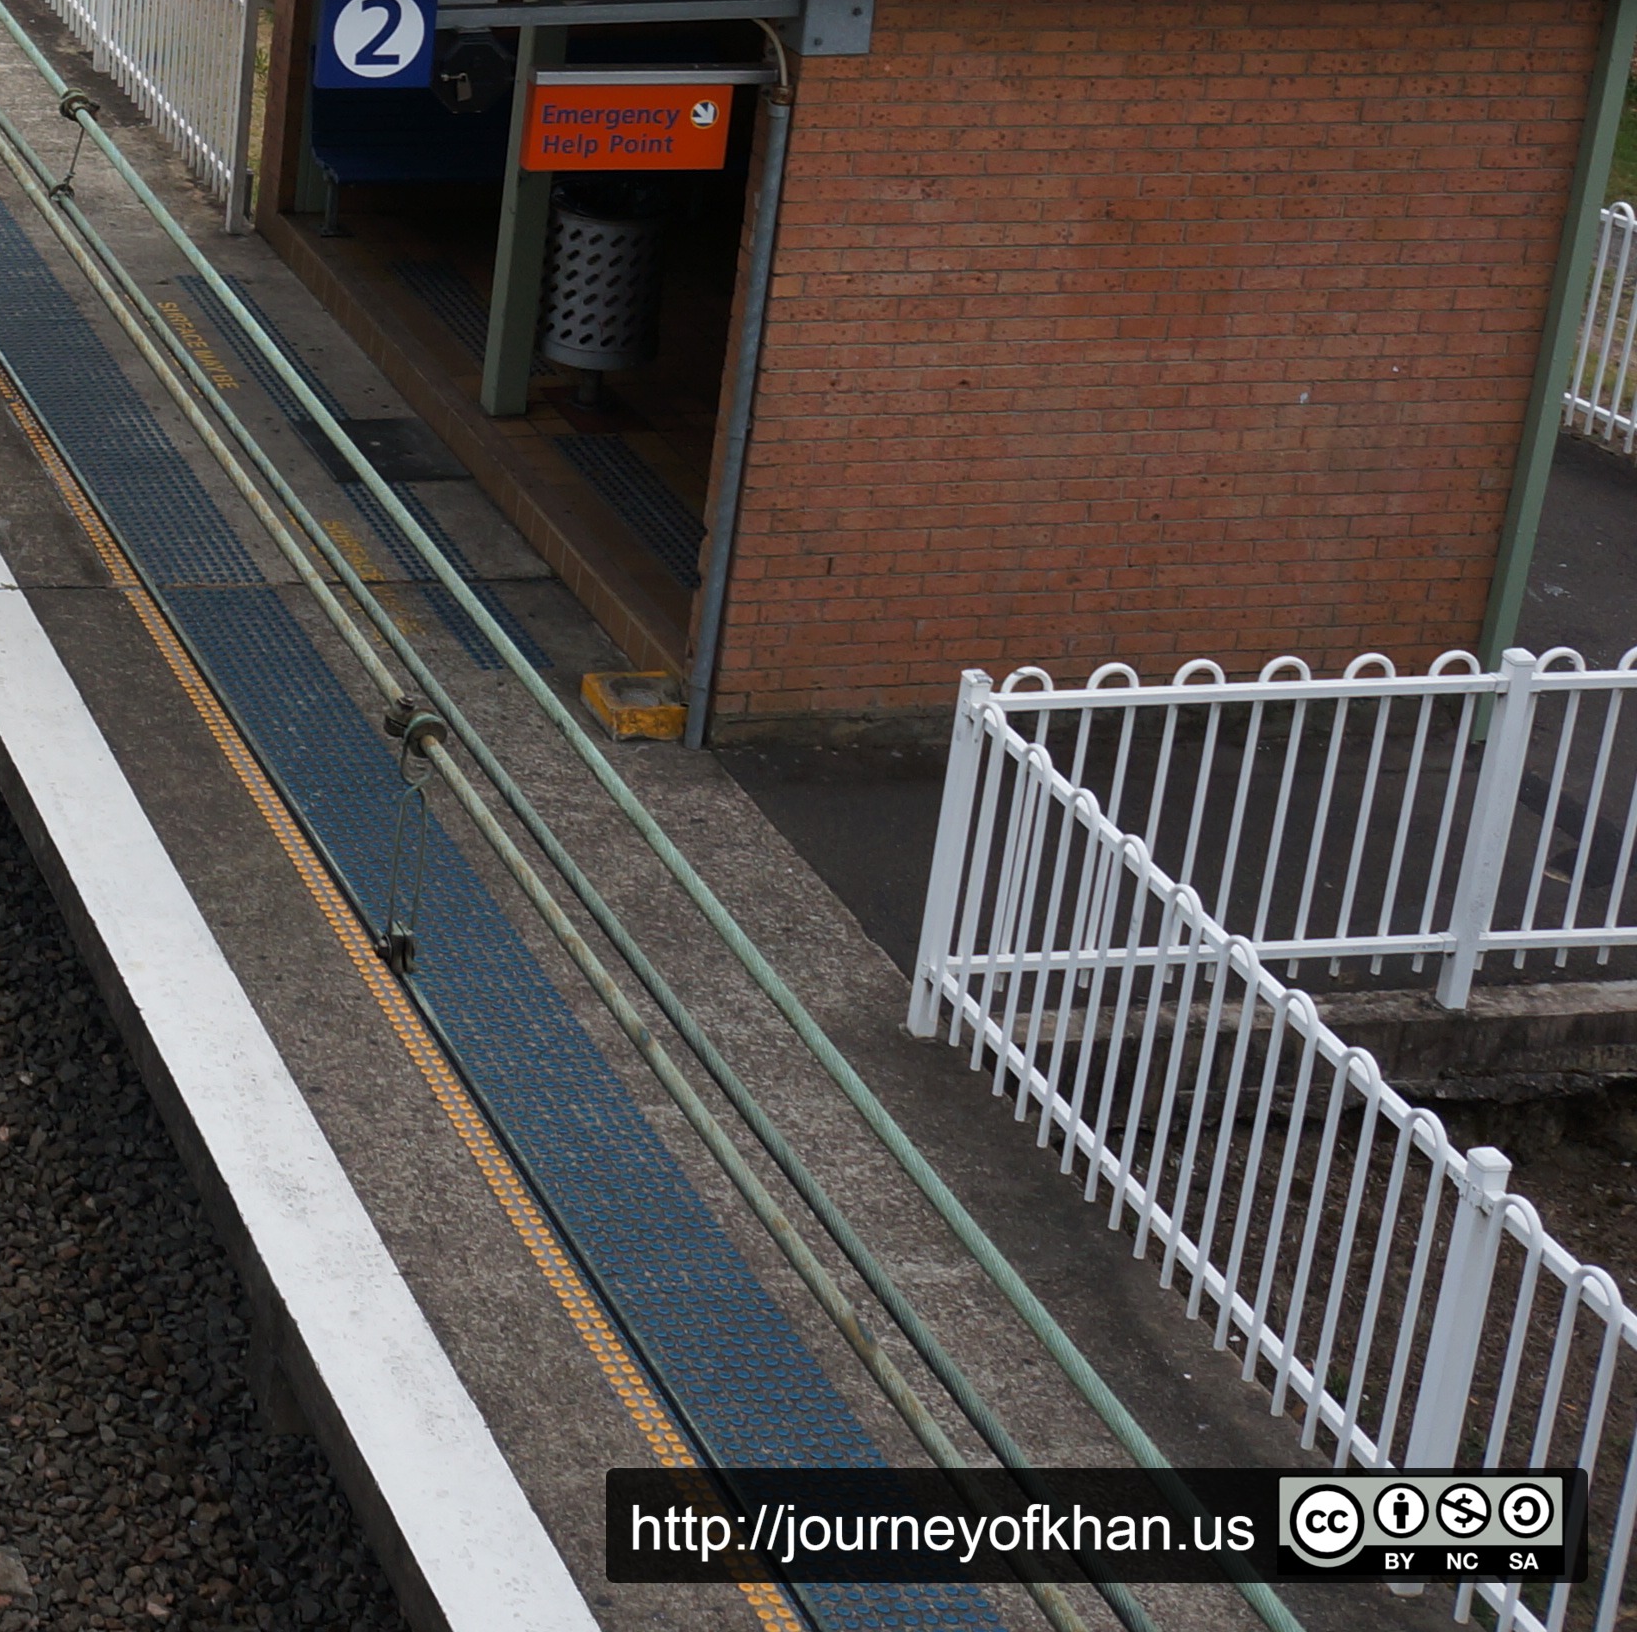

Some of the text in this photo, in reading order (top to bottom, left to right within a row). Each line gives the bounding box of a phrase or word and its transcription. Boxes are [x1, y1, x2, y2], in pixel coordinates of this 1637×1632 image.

[541, 104, 680, 130] Emergency
[542, 134, 675, 158] Help Point
[156, 302, 209, 348] SURFACE
[193, 350, 228, 373] MAY
[211, 374, 240, 390] BE
